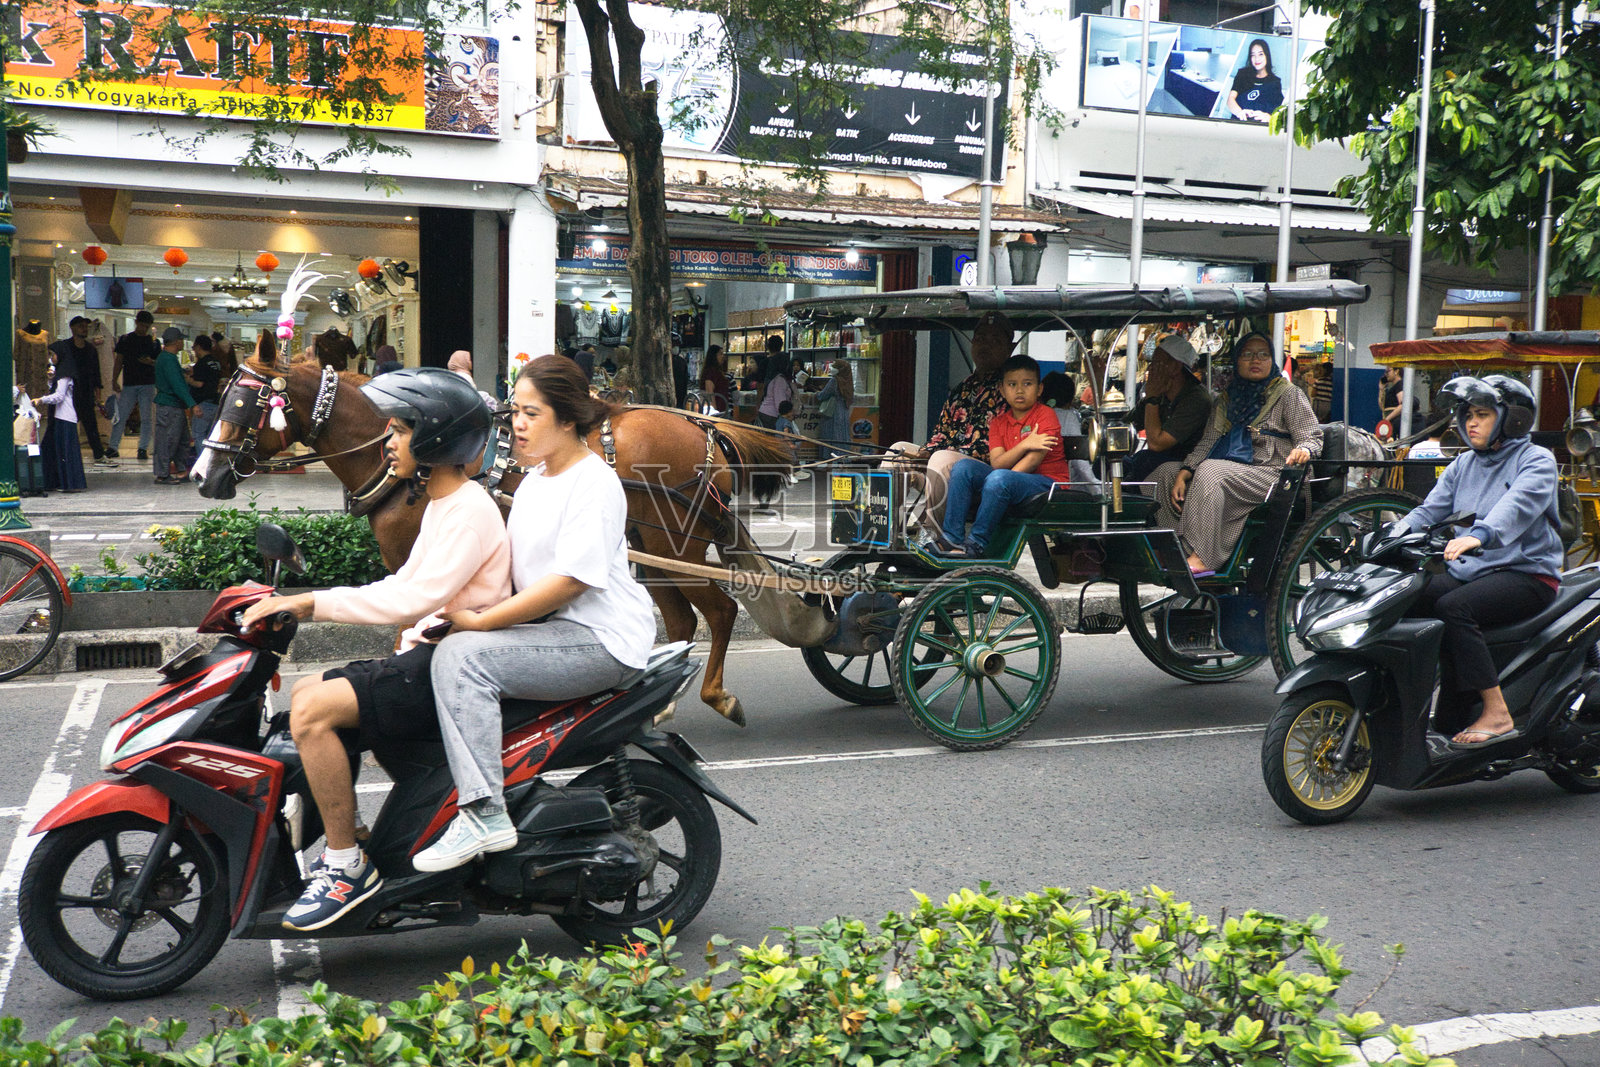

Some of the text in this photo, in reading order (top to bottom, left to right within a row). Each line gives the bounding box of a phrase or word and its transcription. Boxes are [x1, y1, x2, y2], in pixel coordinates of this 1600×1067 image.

[85, 87, 197, 109] Yogyakarta
[767, 116, 795, 128] ANEKA
[835, 128, 860, 139] BATIK
[887, 132, 935, 145] ACCESSORIES
[954, 134, 986, 146] MINUMA
[853, 152, 873, 163] Yani
[875, 155, 890, 165] No.
[891, 156, 902, 166] 51
[903, 157, 947, 170] Malioboro
[682, 250, 719, 264] TOKO
[791, 255, 871, 272] TRADISIONAL
[177, 752, 266, 779] 125
